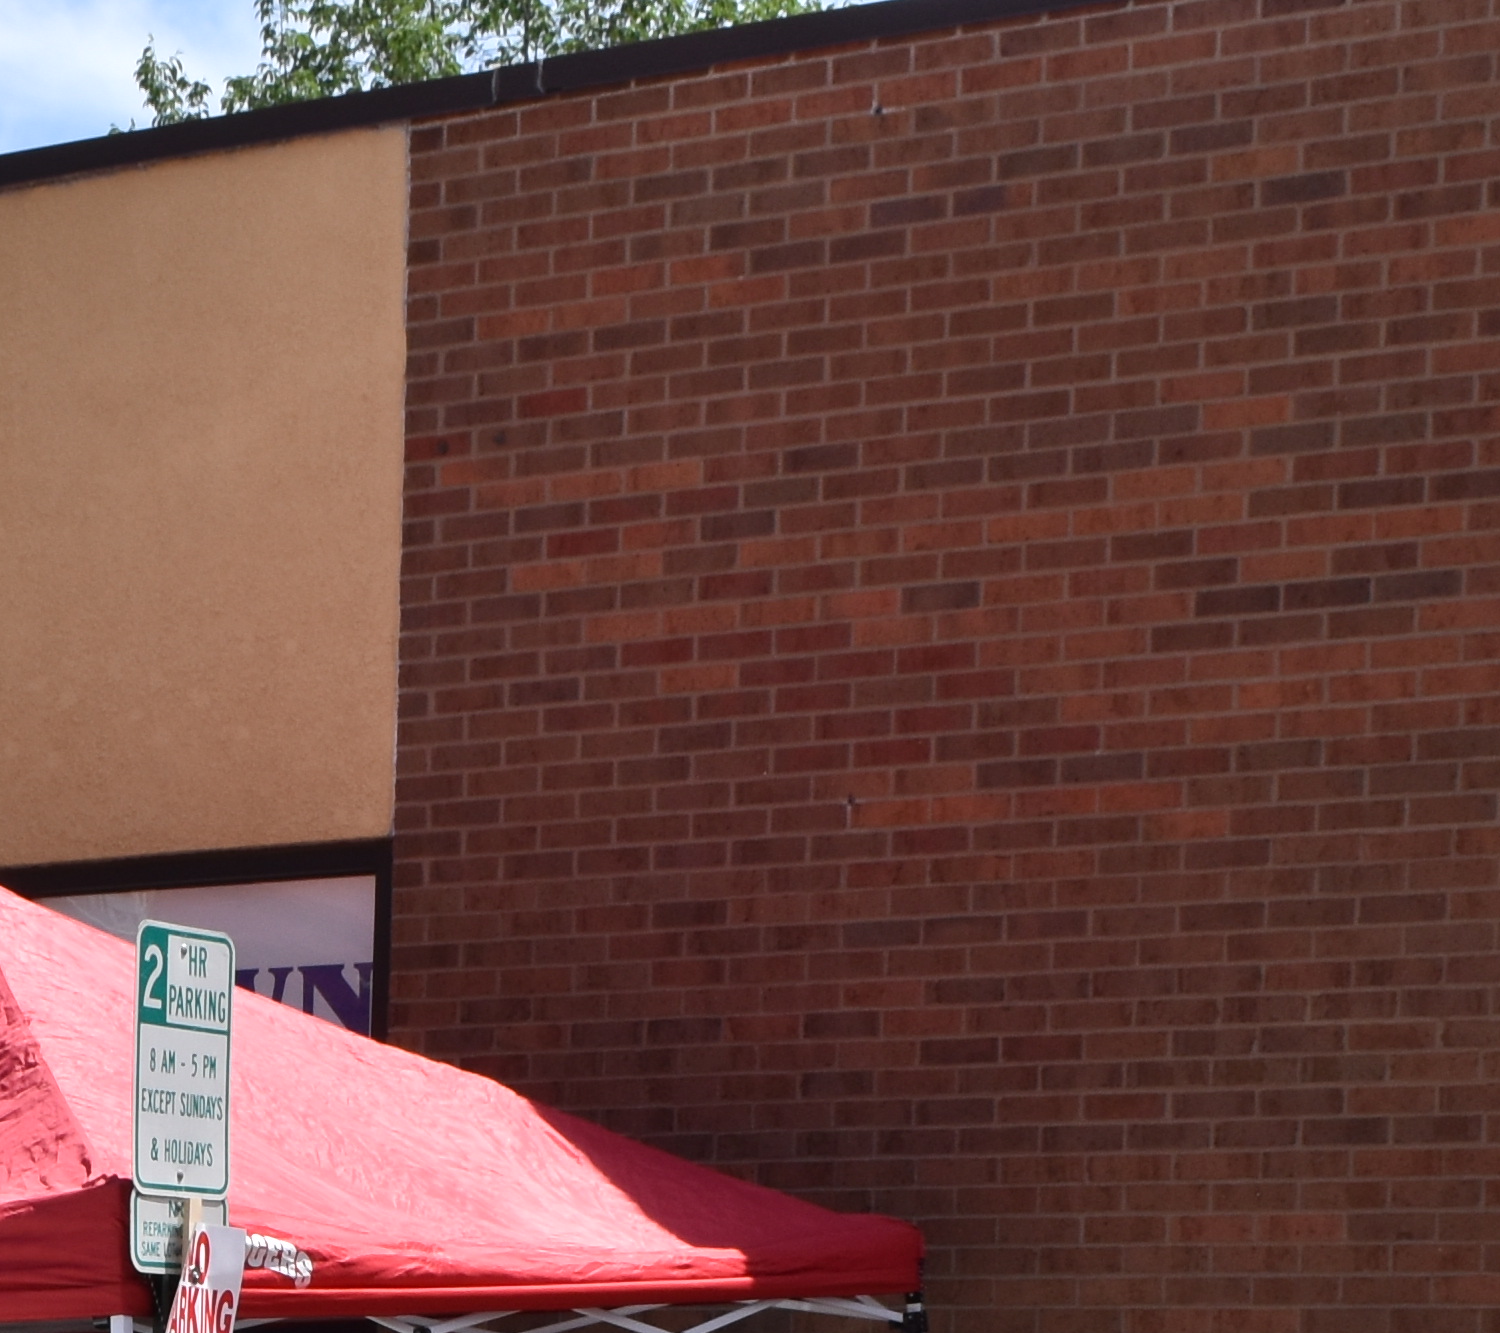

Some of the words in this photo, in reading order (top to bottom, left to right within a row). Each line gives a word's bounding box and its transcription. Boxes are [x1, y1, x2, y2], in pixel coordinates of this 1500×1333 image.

[143, 944, 163, 1010] 2
[189, 945, 207, 978] HR
[169, 984, 226, 1023] PARKING
[150, 1048, 156, 1072] 8
[161, 1050, 176, 1074] AM
[191, 1054, 198, 1077] 5
[203, 1055, 217, 1079] PM
[141, 1088, 176, 1115] EXCEPT
[180, 1092, 223, 1121] SUNDAYS
[151, 1137, 158, 1161] &
[164, 1139, 213, 1167] HOLIDAYS
[245, 1233, 313, 1290] GERS
